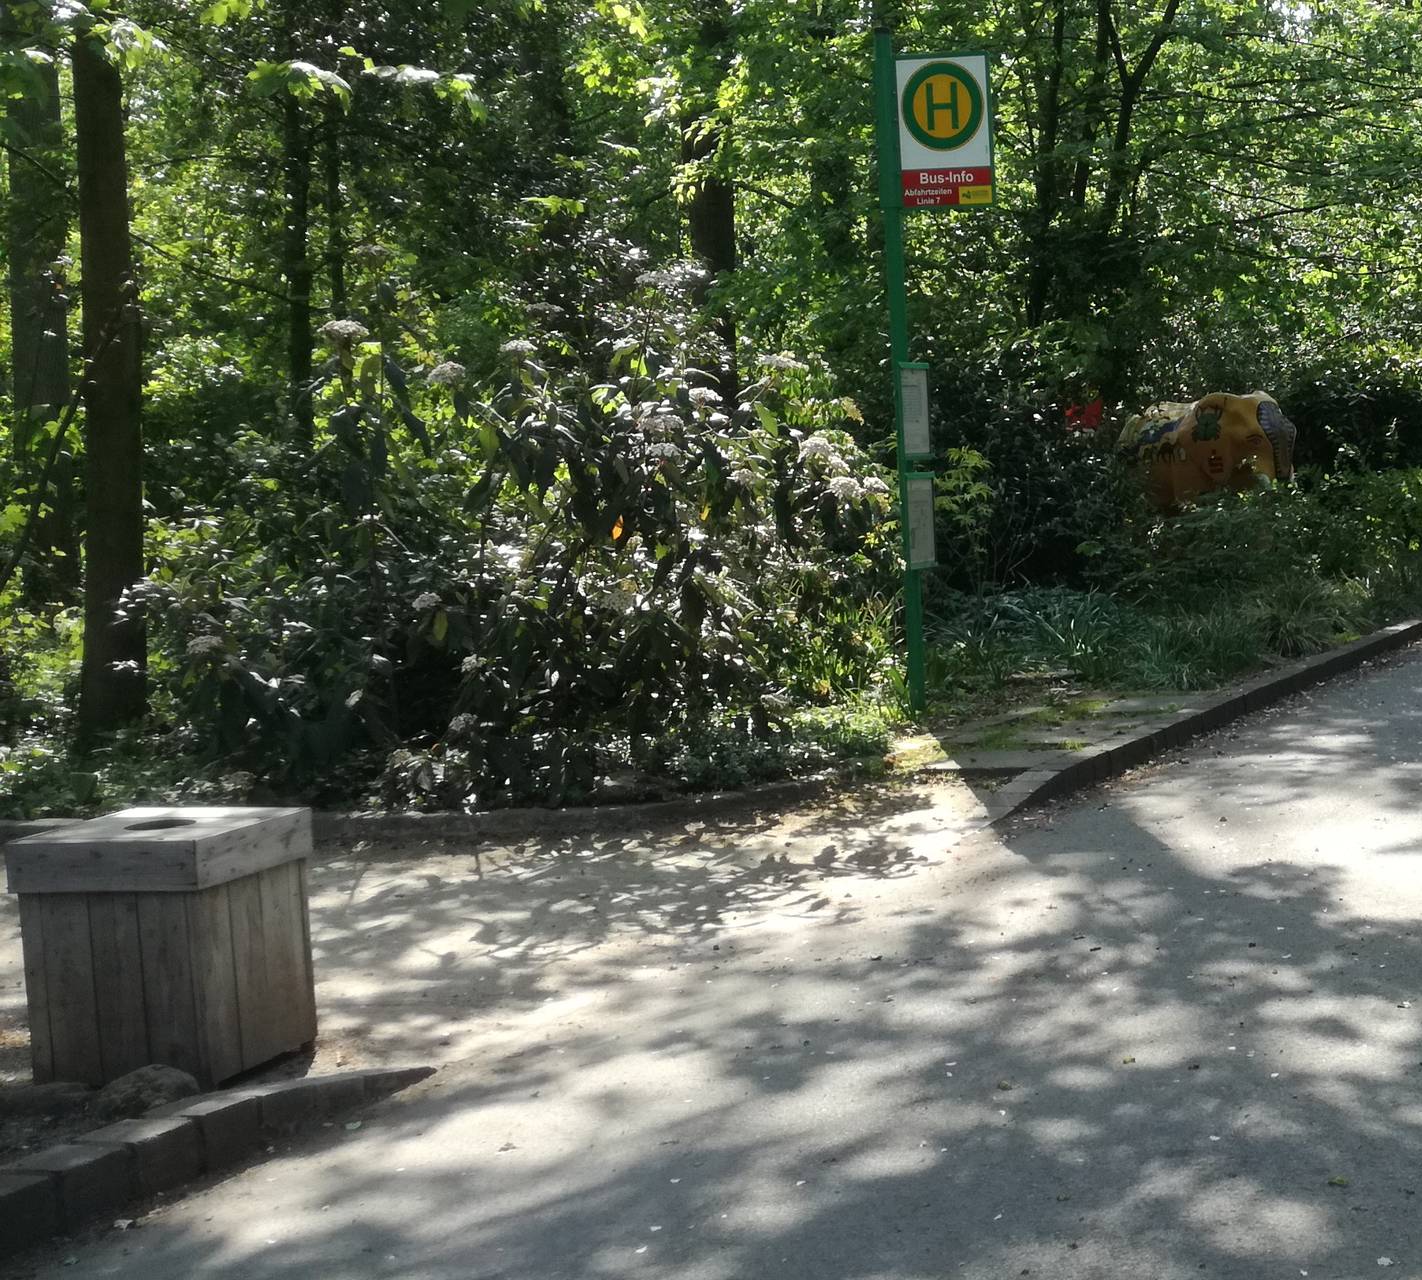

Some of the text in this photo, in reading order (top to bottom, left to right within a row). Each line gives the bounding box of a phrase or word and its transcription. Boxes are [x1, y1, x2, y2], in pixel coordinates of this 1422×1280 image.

[926, 82, 959, 130] H
[920, 171, 974, 184] Bus-Info
[916, 197, 935, 205] Linie
